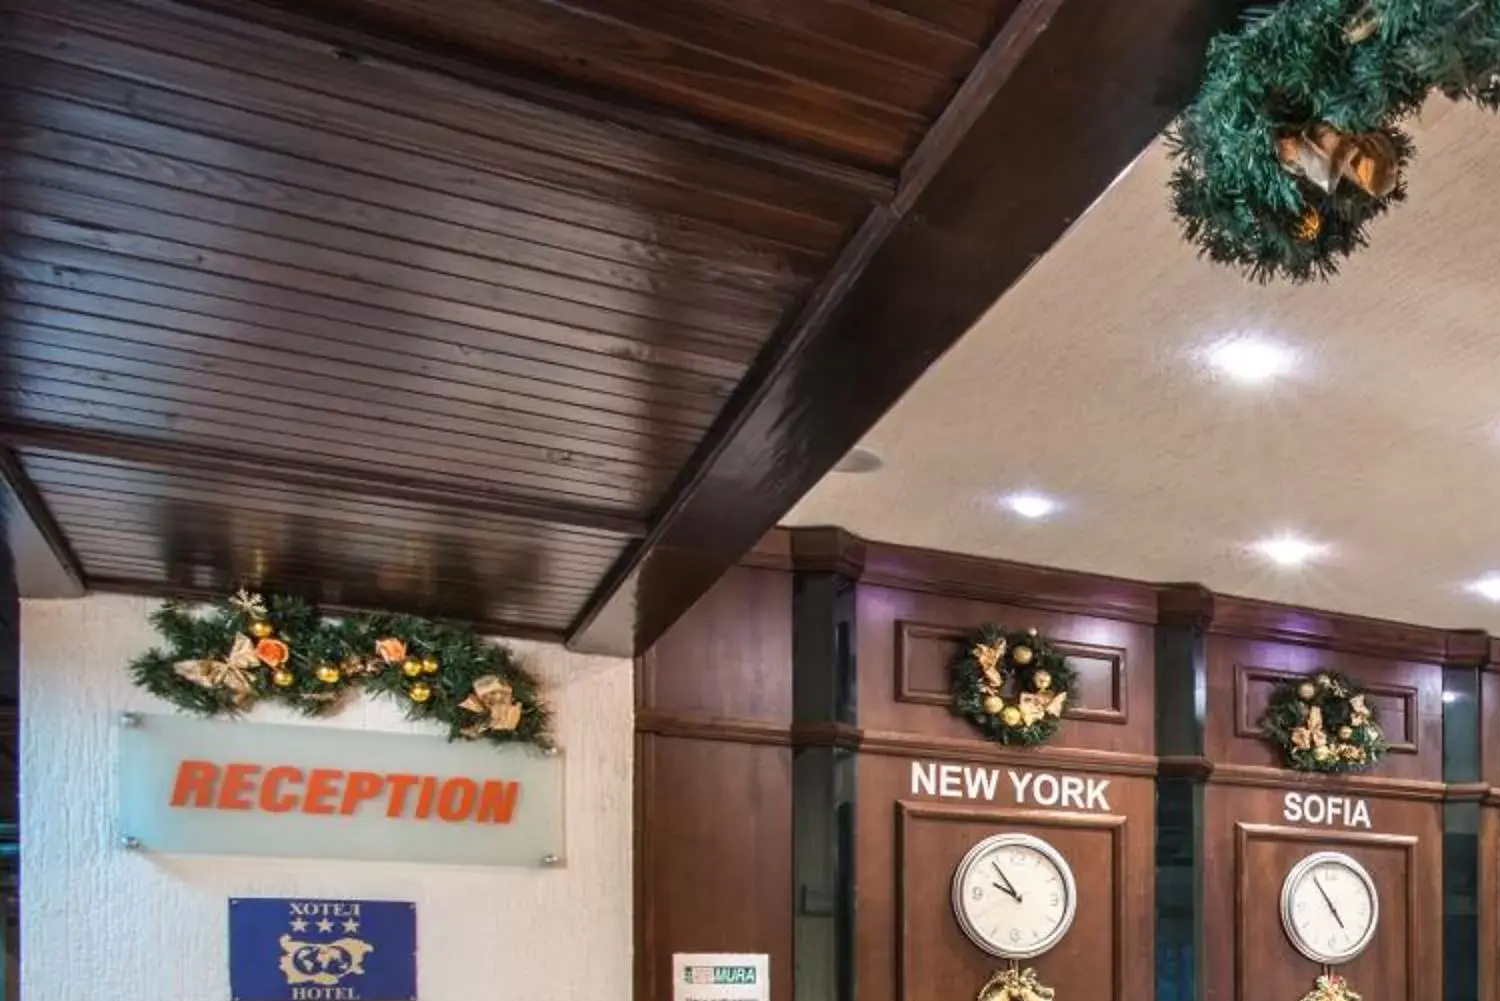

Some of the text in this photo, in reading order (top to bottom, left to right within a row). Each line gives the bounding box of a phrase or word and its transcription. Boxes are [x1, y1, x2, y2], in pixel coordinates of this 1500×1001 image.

[169, 759, 521, 825] RECEPTION
[911, 761, 1111, 812] NEW YORK
[1283, 792, 1372, 829] SOFIA
[289, 902, 361, 917] ХОТЕЛ
[715, 967, 755, 982] MURA
[291, 986, 361, 1001] HOTEL
